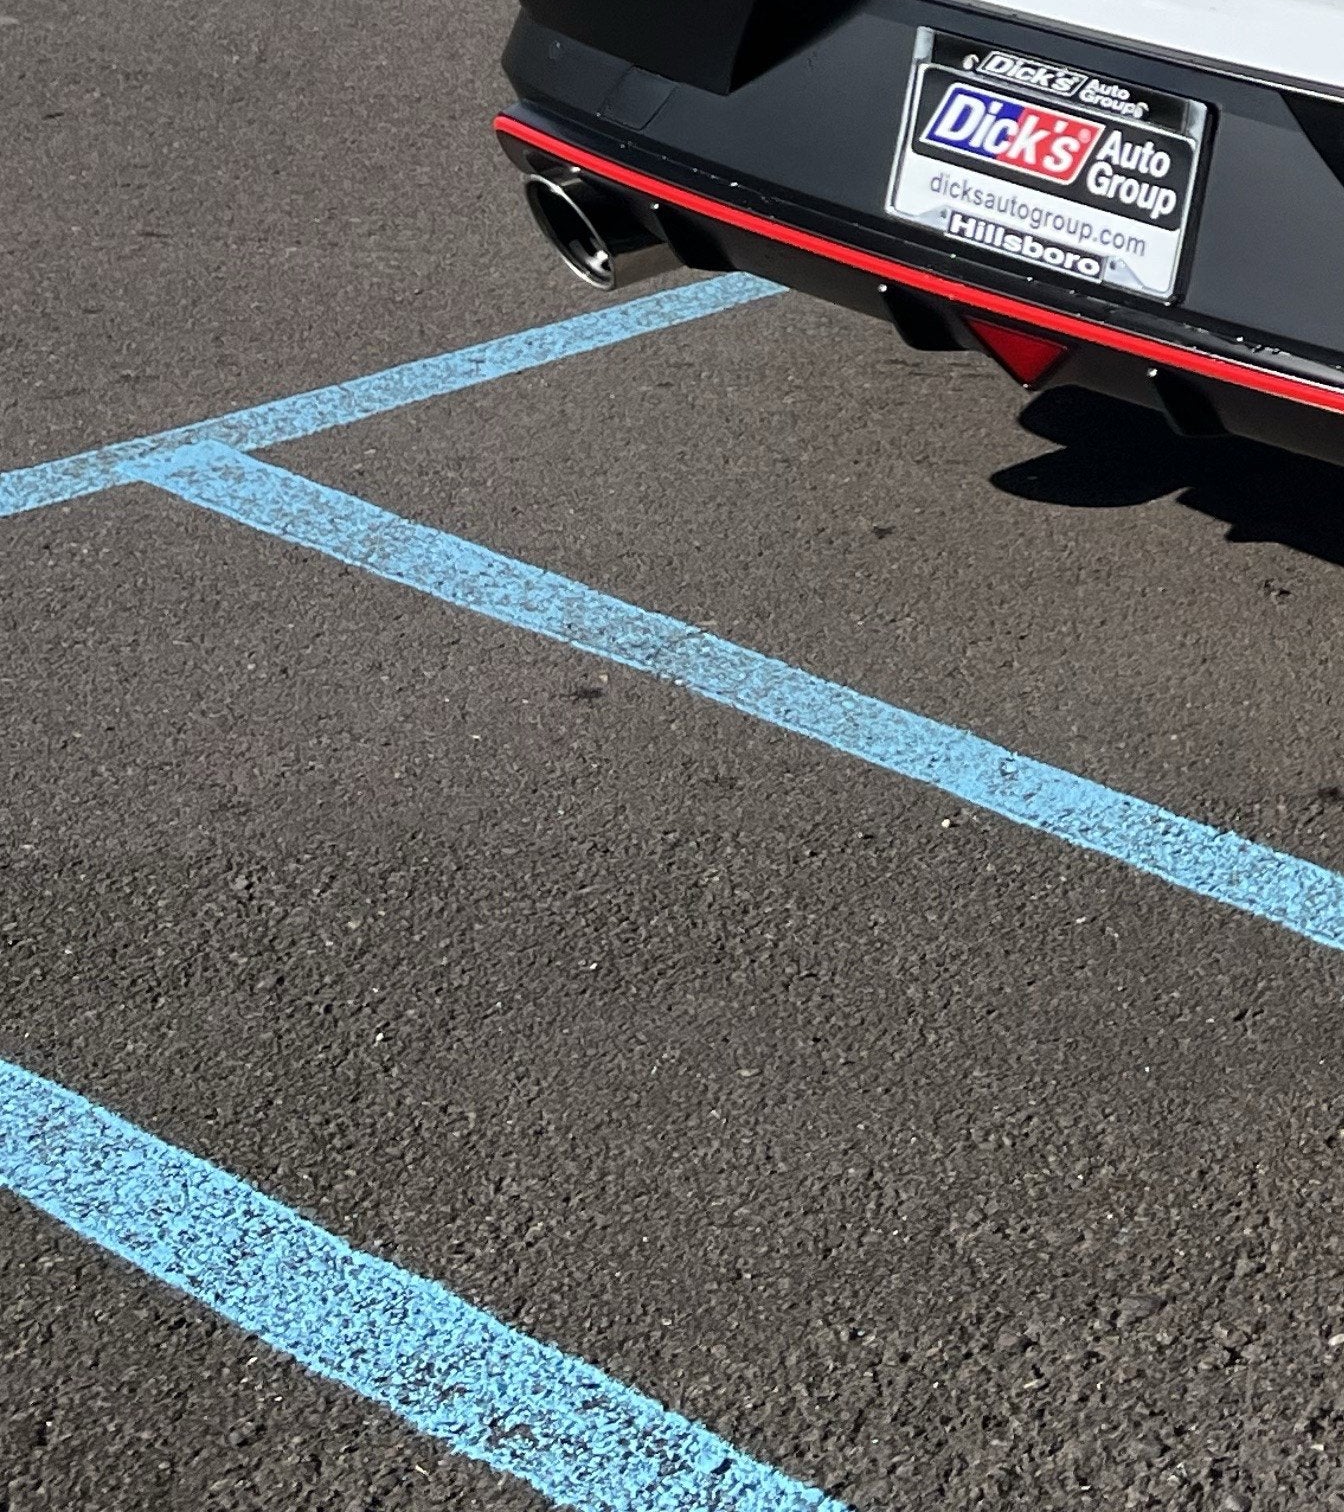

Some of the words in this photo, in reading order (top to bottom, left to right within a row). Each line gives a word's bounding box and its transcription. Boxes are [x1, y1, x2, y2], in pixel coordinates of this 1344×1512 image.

[984, 55, 1080, 92] Dick's
[1085, 79, 1131, 101] Auto
[1078, 89, 1138, 116] Group
[934, 92, 1081, 174] Dick's
[1096, 129, 1171, 178] Auto
[930, 172, 1146, 257] dicksautogroup.com
[1086, 161, 1177, 219] Group
[949, 213, 1101, 277] Hillsboro
